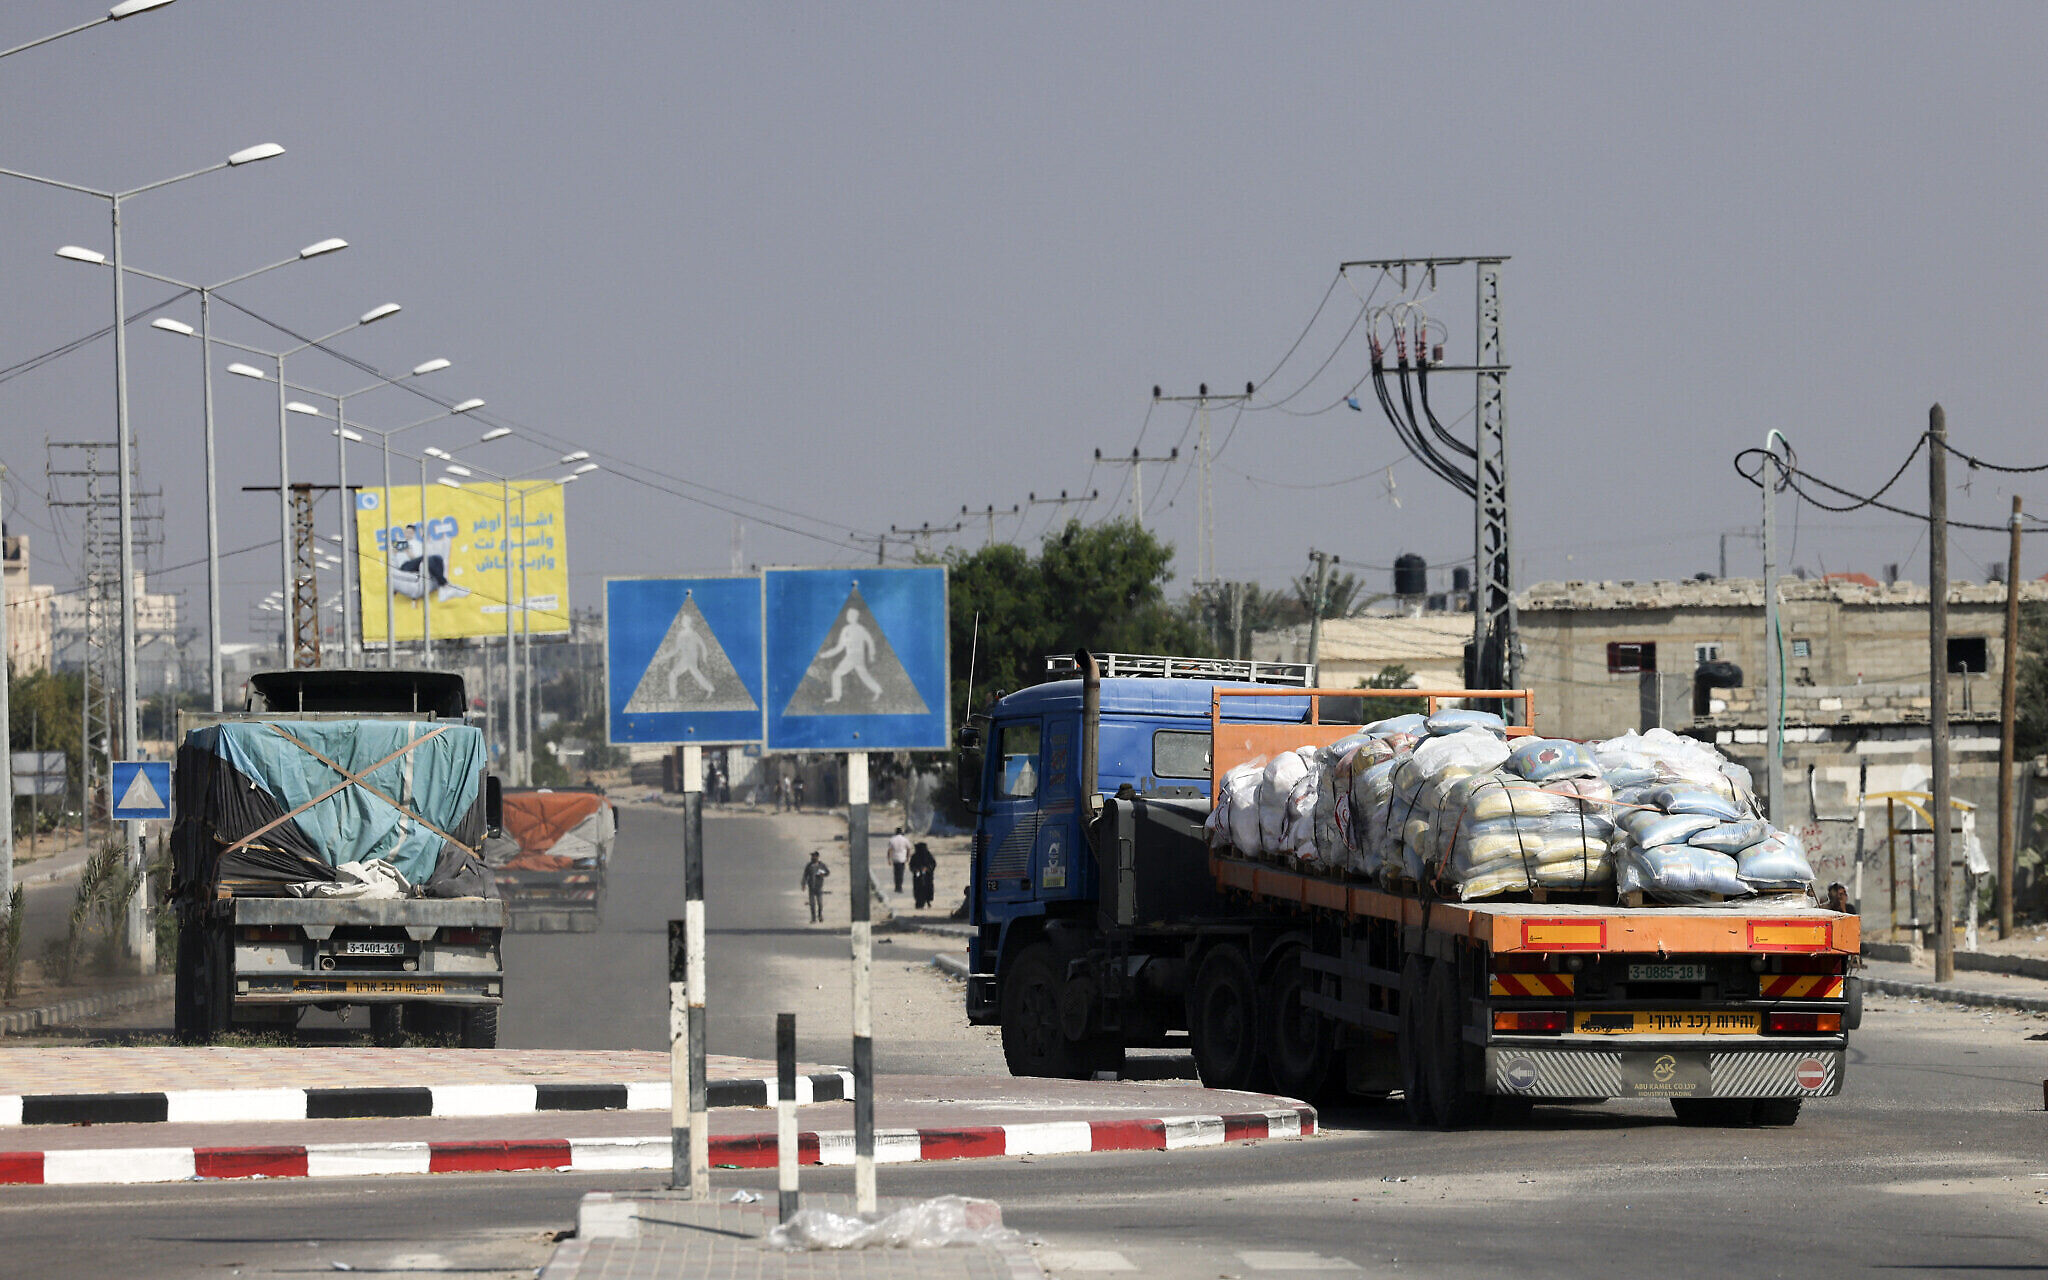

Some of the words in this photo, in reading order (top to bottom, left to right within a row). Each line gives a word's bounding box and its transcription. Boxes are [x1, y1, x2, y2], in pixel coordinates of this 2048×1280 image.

[350, 943, 395, 953] 3-1401-16
[1632, 965, 1693, 979] 3-0885-18
[353, 982, 377, 993] ארוך
[381, 982, 402, 992] רכב
[1649, 1015, 1682, 1031] ארוך!
[1688, 1015, 1711, 1029] רכב
[1716, 1015, 1755, 1029] זהירות
[1653, 1063, 1676, 1074] AK
